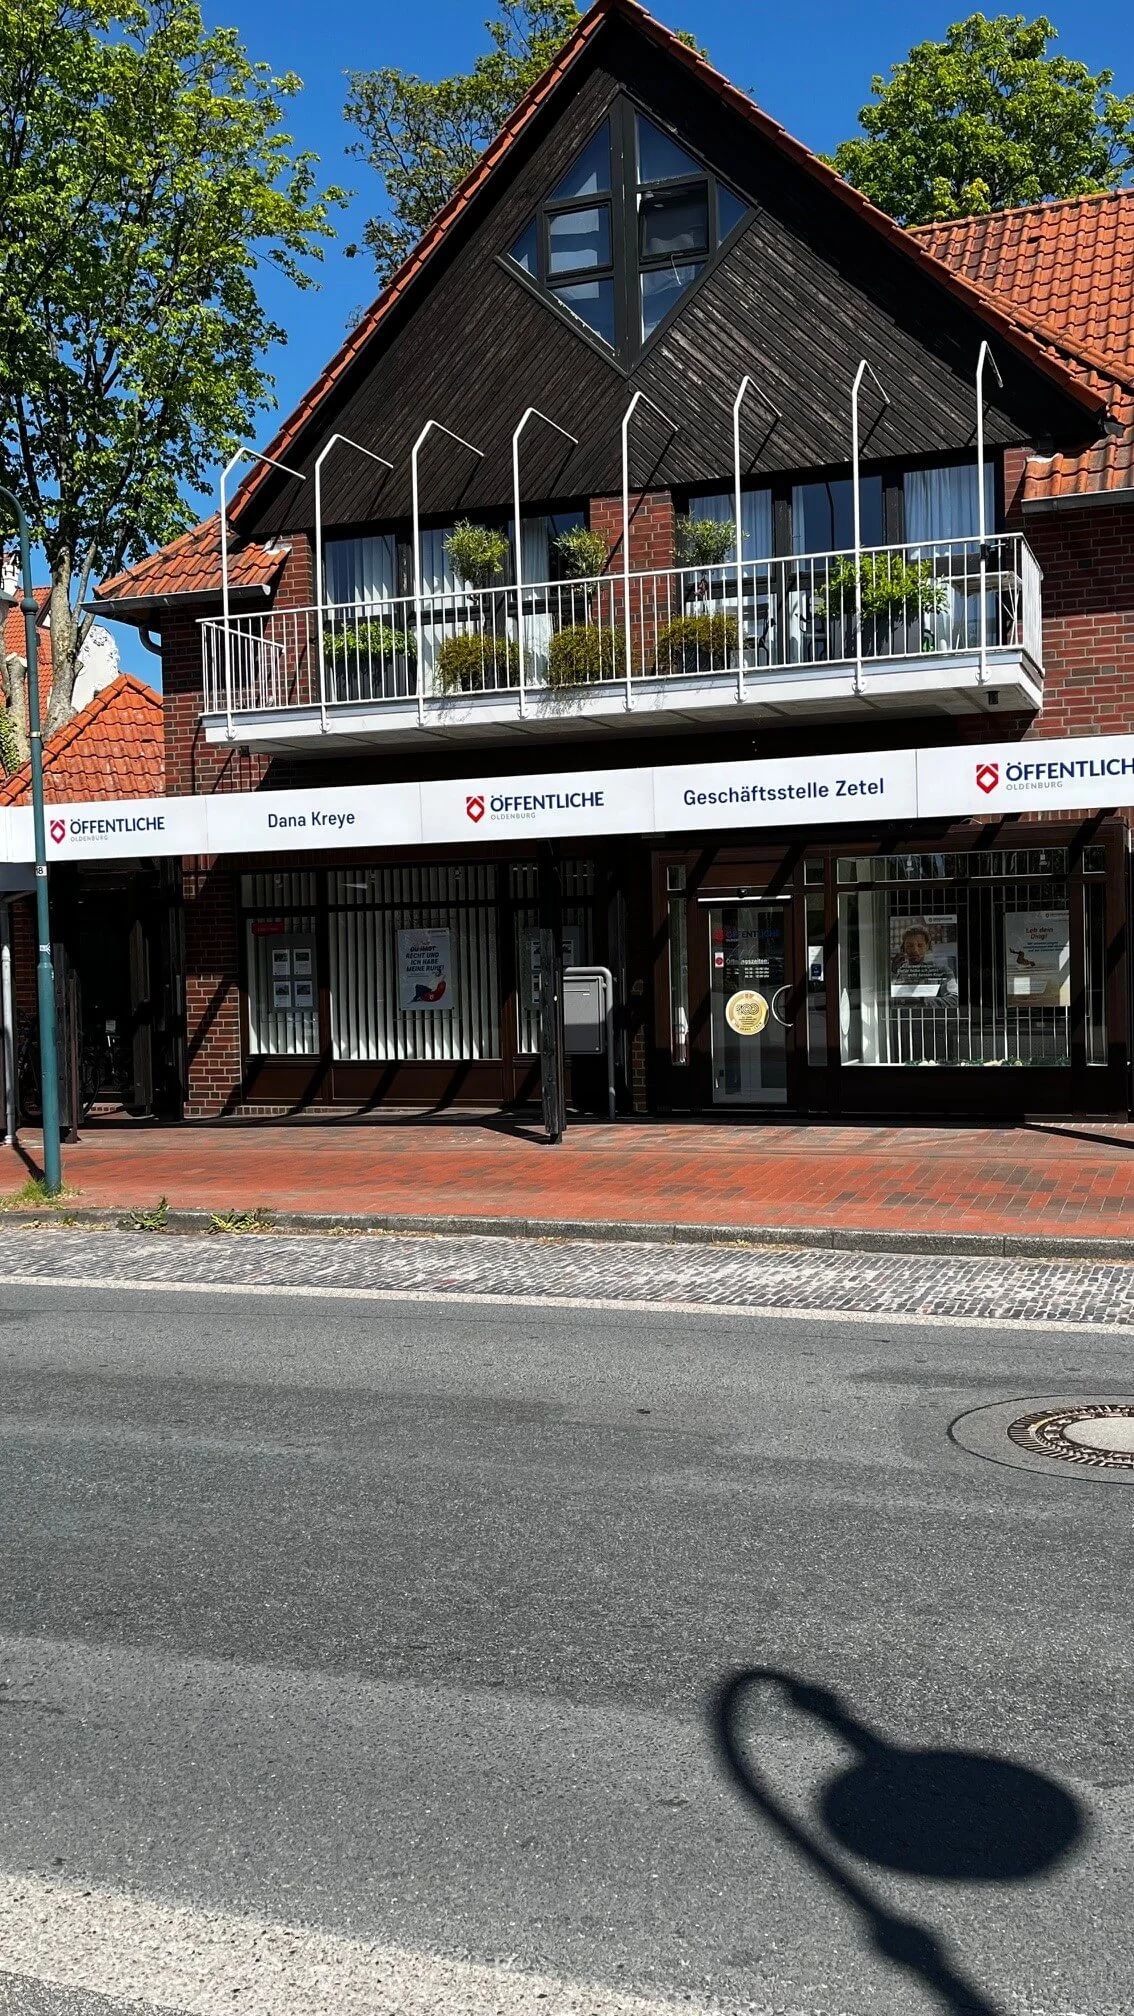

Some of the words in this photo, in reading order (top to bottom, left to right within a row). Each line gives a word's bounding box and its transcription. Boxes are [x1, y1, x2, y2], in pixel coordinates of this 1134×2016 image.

[683, 782, 830, 806] Geschäftsstelle
[835, 777, 884, 797] Zetel
[1005, 780, 1064, 791] OLDENBURG
[490, 791, 605, 813] ÖFFENTLICHE
[70, 816, 166, 835] ÖFFENTLICHE
[267, 813, 307, 828] Dana
[311, 811, 355, 829] Kreye
[490, 812, 536, 821] OLDENBURG
[70, 834, 109, 843] OLDENBURG
